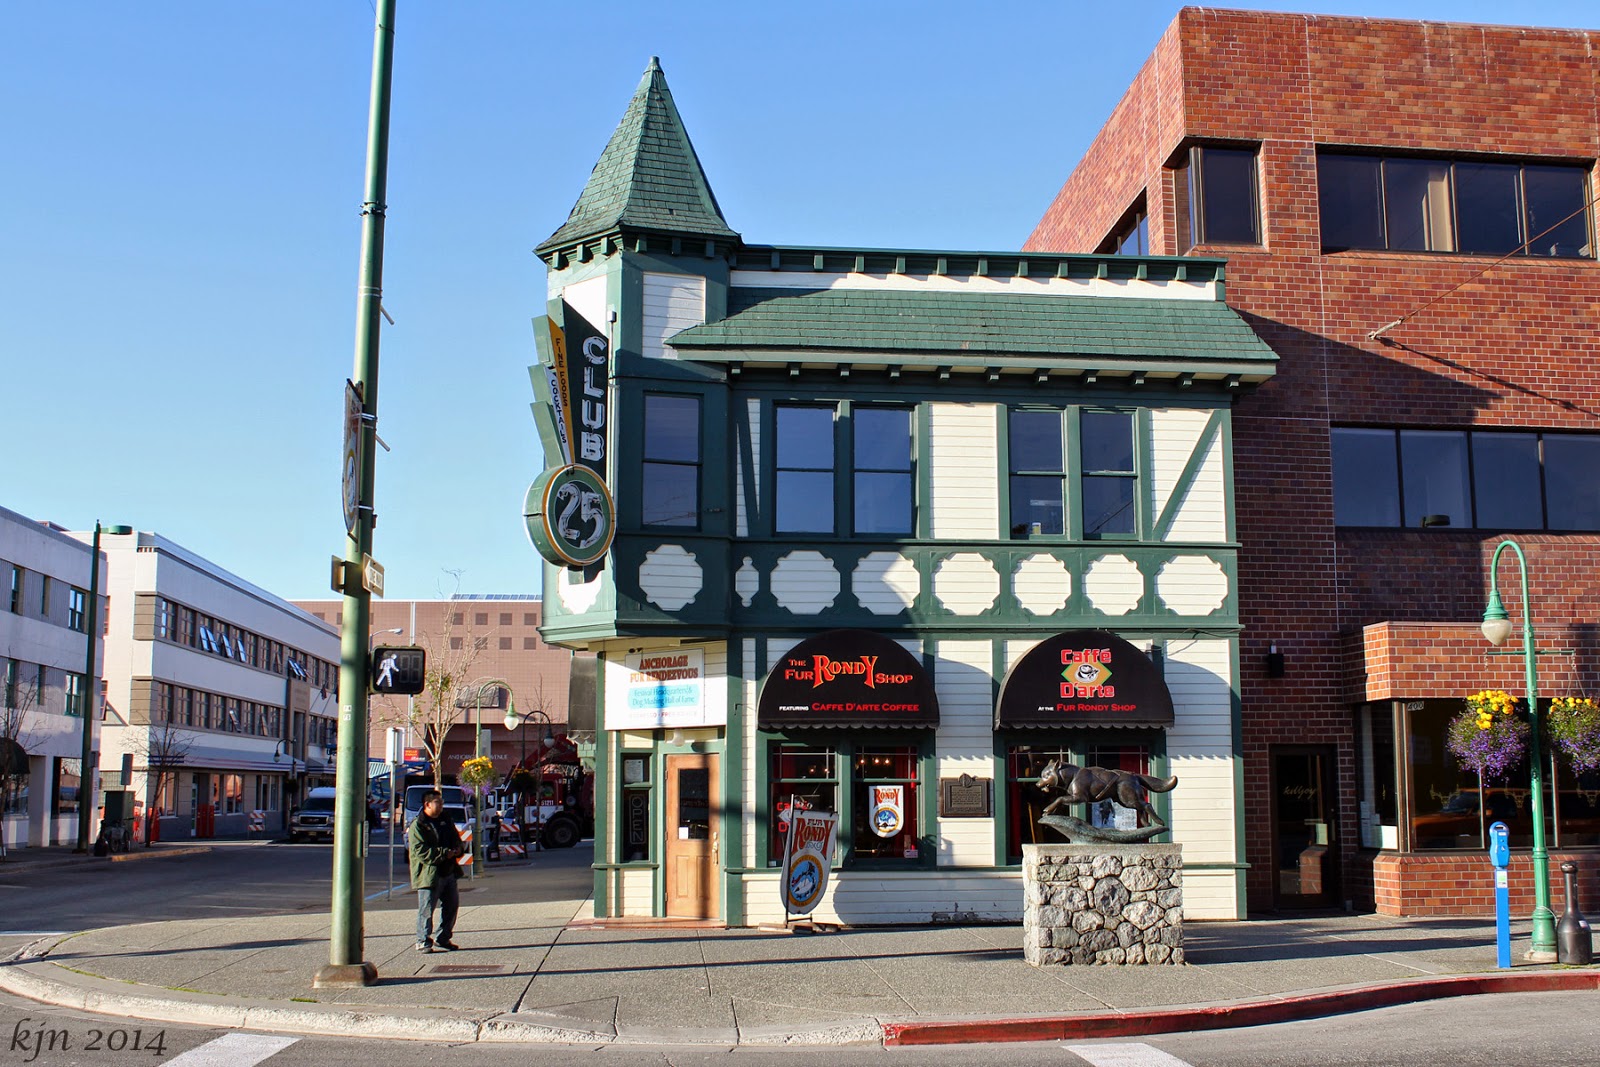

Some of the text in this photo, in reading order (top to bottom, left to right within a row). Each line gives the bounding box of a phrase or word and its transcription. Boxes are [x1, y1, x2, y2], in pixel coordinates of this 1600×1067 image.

[555, 338, 568, 407] FINE FOODS
[550, 380, 566, 443] COCKTAILS
[581, 336, 608, 462] CLUB
[556, 483, 605, 549] 25
[639, 655, 688, 670] ANCHORAGE
[646, 668, 698, 681] RENDEZVOUS
[784, 655, 913, 689] FUR RONDY SHOP
[811, 702, 844, 711] CAFFE
[845, 702, 880, 711] D'ARTE
[881, 703, 919, 711] COFFEE
[1056, 703, 1076, 711] FUR
[1077, 703, 1109, 711] RONDY
[1111, 703, 1137, 711] SHOP
[873, 788, 900, 809] RONDY
[631, 796, 644, 842] OPEN
[807, 818, 823, 826] FUR
[791, 817, 836, 860] RONDY
